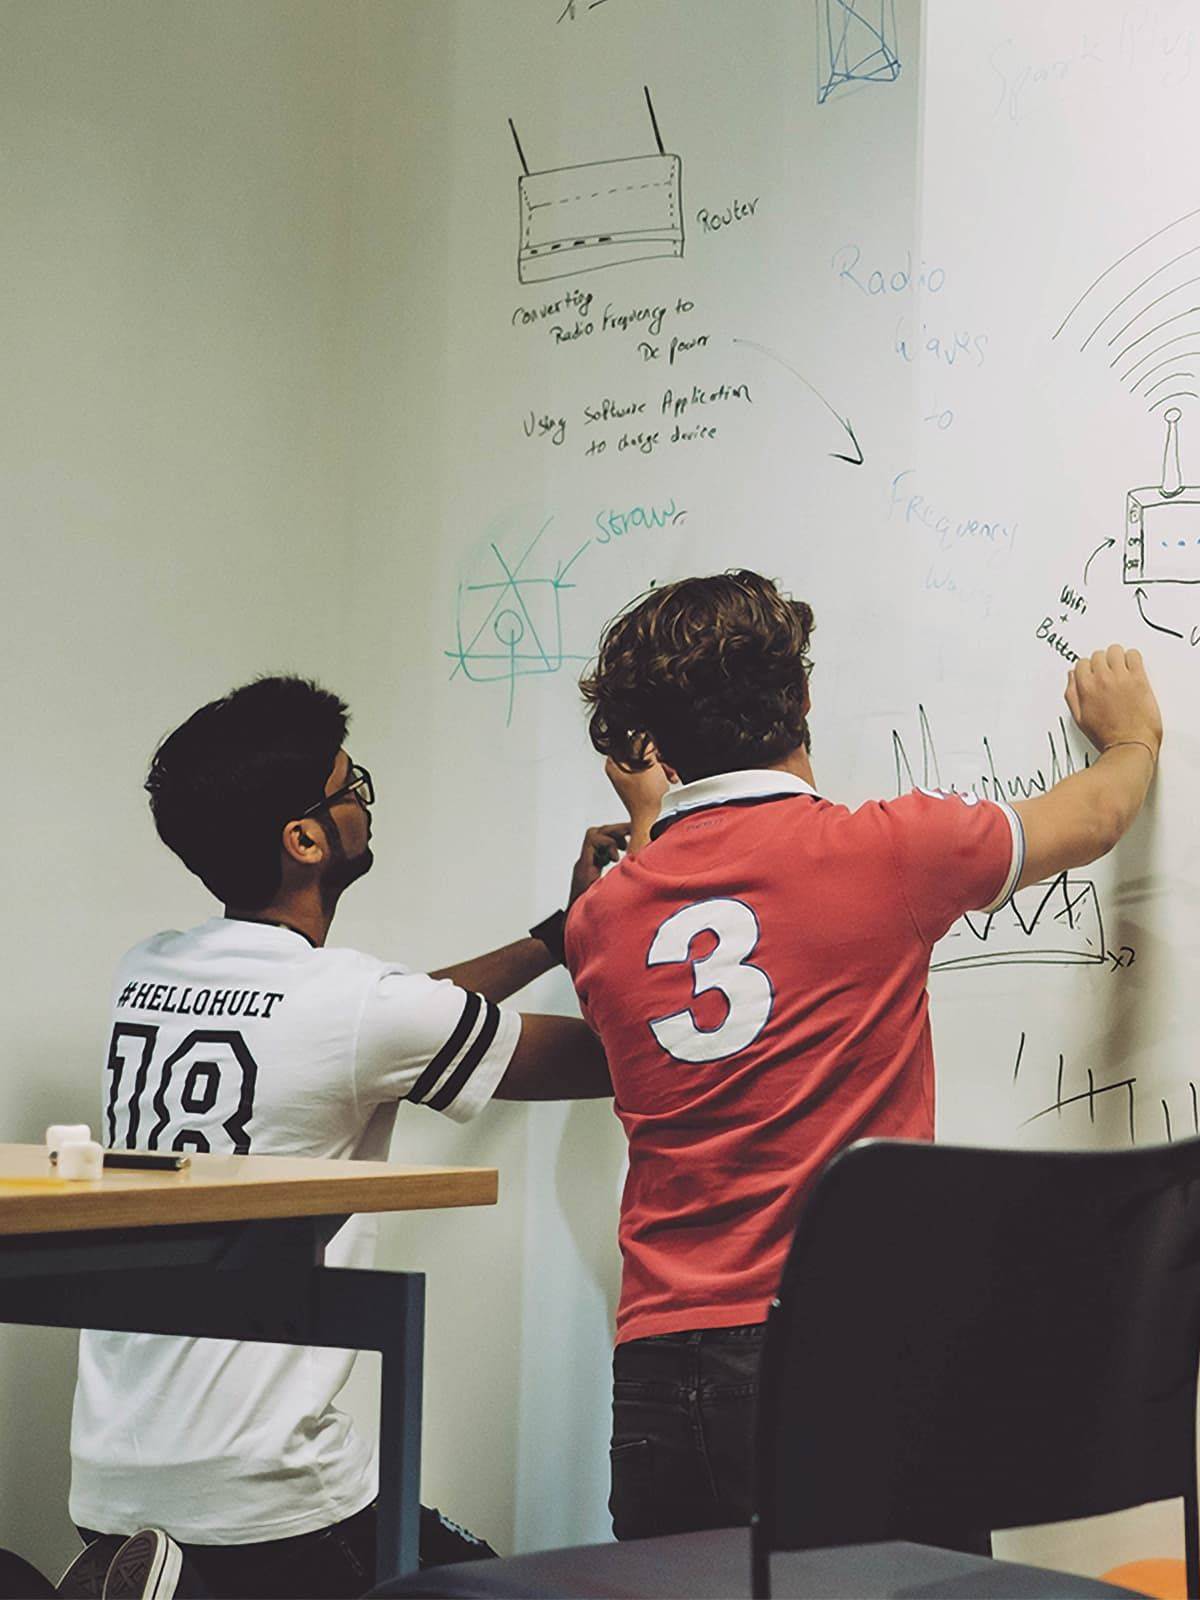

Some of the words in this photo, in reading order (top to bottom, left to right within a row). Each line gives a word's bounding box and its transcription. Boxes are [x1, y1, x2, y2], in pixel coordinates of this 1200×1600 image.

[696, 198, 760, 232] Router
[831, 244, 946, 297] Radio
[549, 321, 594, 345] Radio
[675, 298, 695, 315] to
[523, 409, 567, 447] Using
[584, 440, 607, 457] to
[116, 981, 285, 1019] #HELLOHULT
[645, 896, 775, 1065] 3
[107, 1021, 258, 1155] 18
